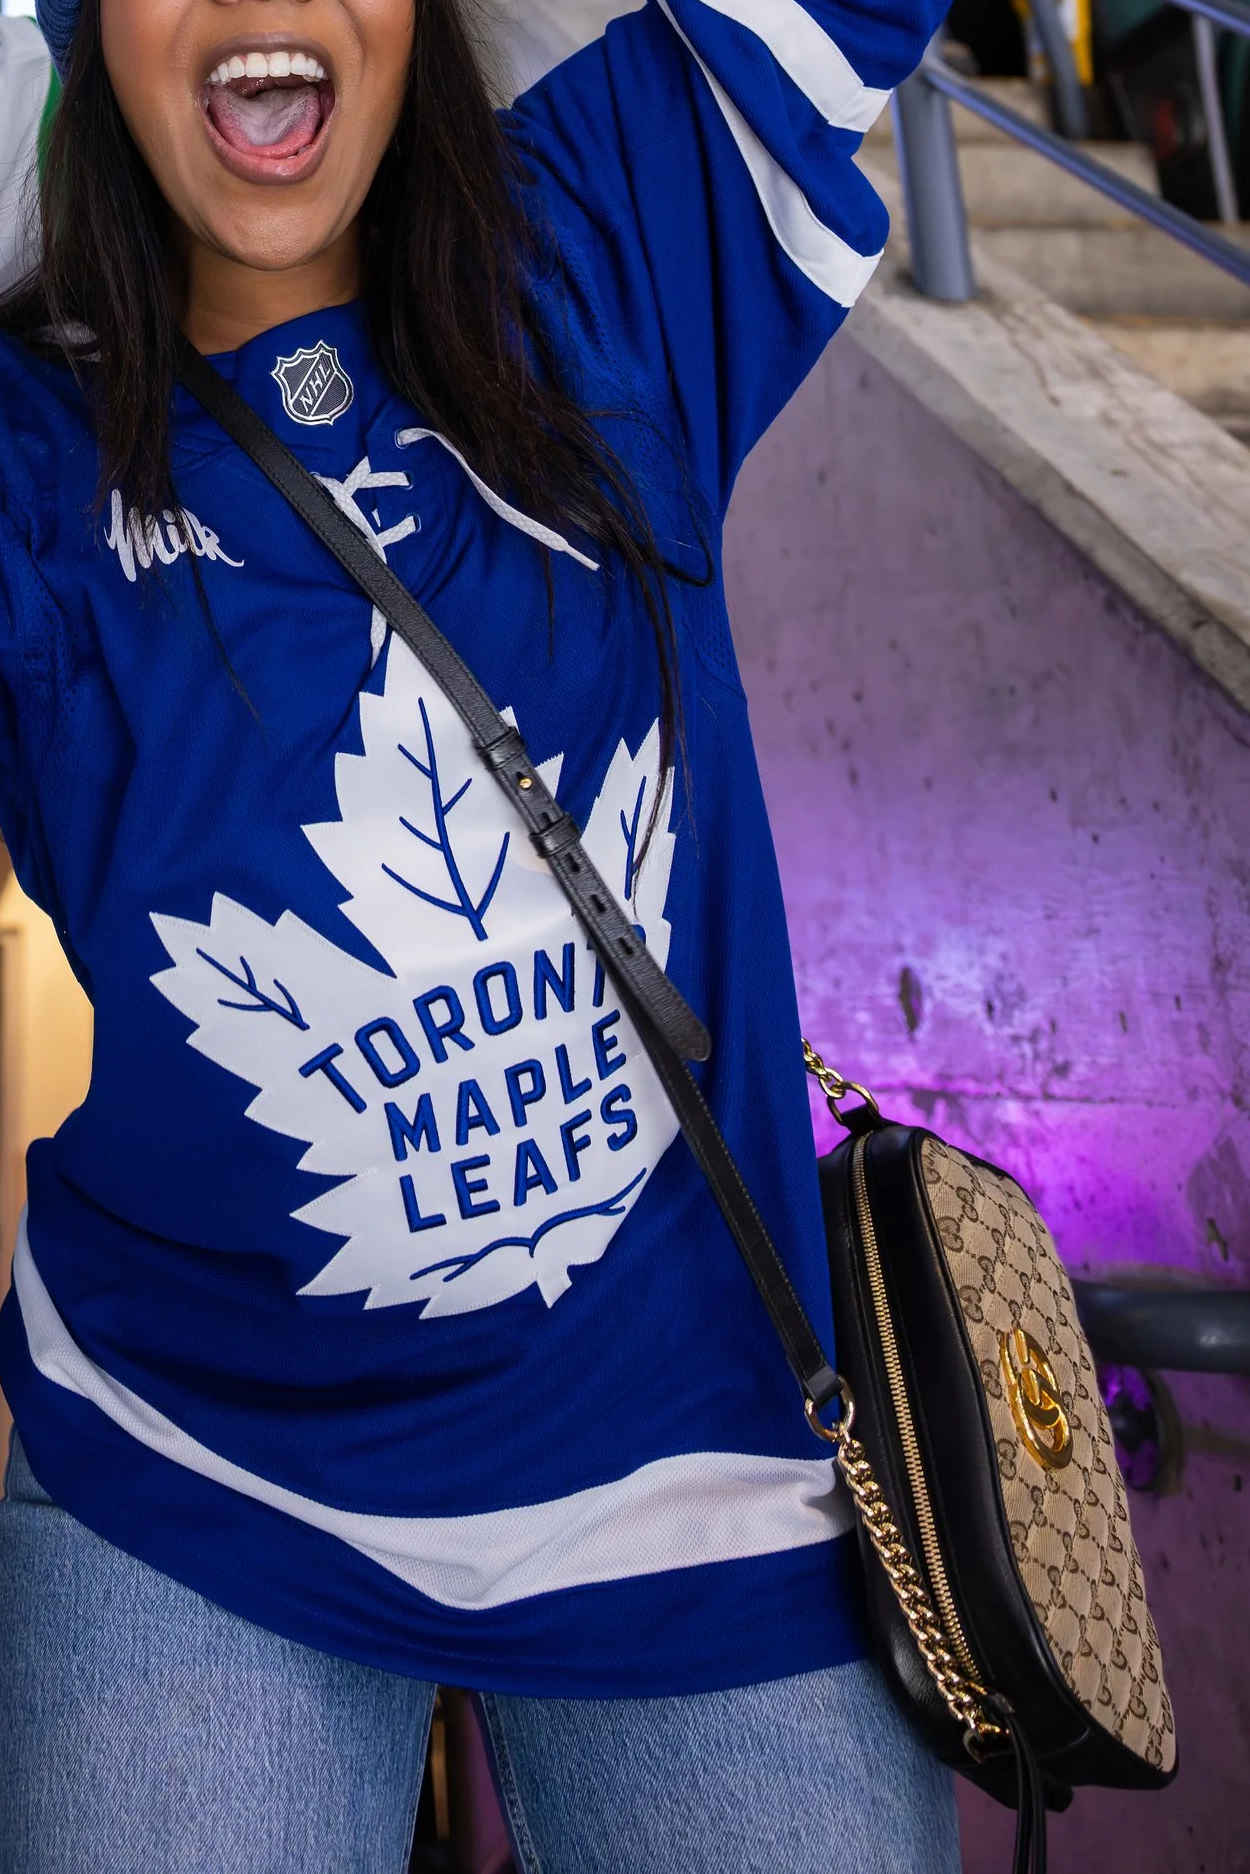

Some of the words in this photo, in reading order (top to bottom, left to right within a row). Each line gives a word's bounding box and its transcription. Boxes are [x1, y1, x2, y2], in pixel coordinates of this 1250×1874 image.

[299, 362, 331, 413] NHL
[103, 488, 245, 583] Milk
[299, 925, 647, 1114] TORONT
[383, 1009, 627, 1162] MAPLE
[398, 1083, 638, 1233] LEAFS
